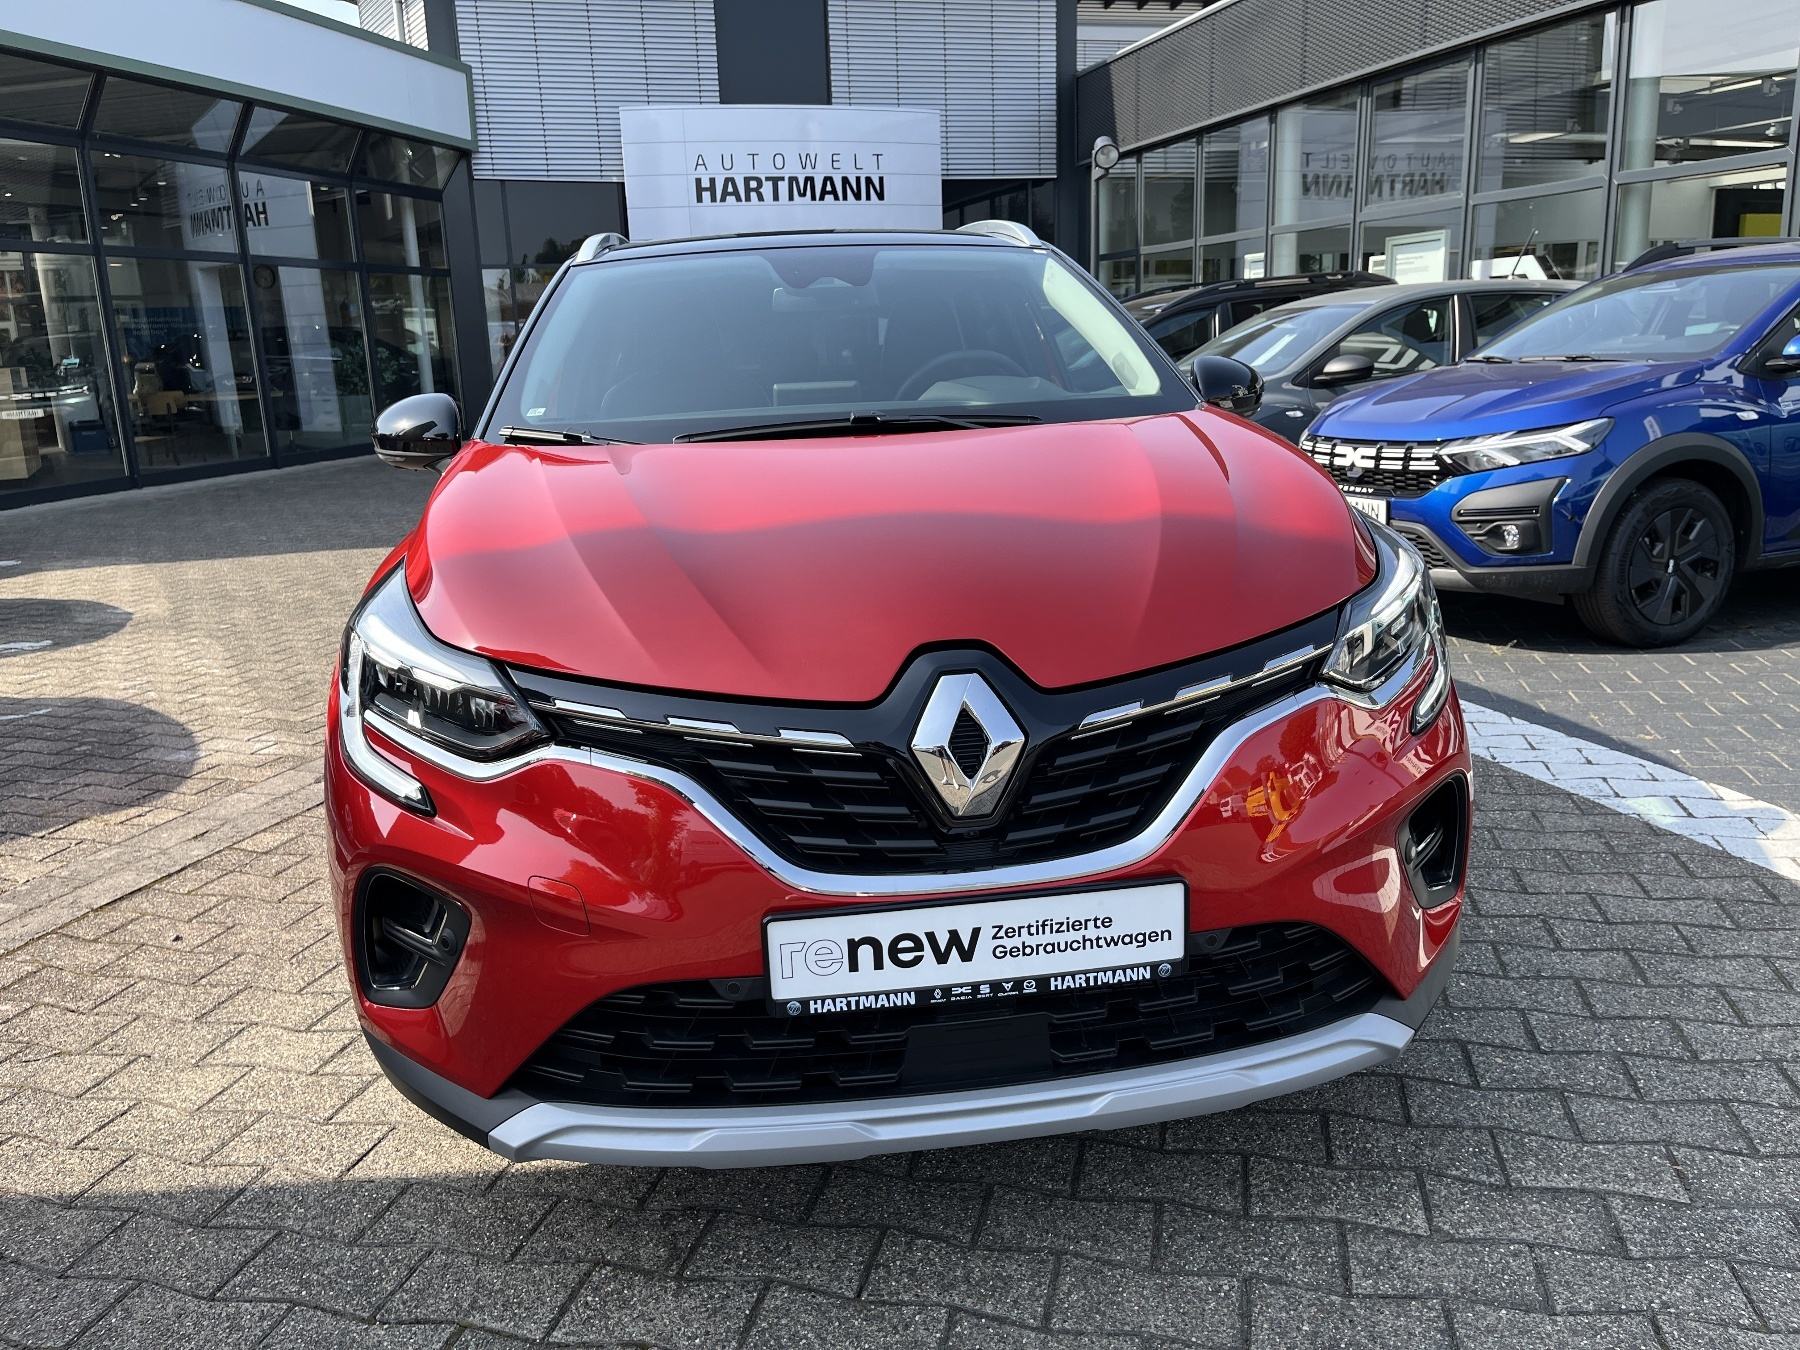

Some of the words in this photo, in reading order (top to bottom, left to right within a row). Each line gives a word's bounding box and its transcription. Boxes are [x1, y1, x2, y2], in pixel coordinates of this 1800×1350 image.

[694, 153, 884, 171] AUTOWELT
[694, 175, 885, 203] HARTMANN
[1338, 484, 1374, 493] TEPWAY
[991, 915, 1113, 940] Zertifizierte
[778, 926, 982, 980] renew
[992, 929, 1172, 959] Gebrauchtwagen
[1050, 966, 1151, 991] HARTMANN
[809, 991, 916, 1014] HARTMANN
